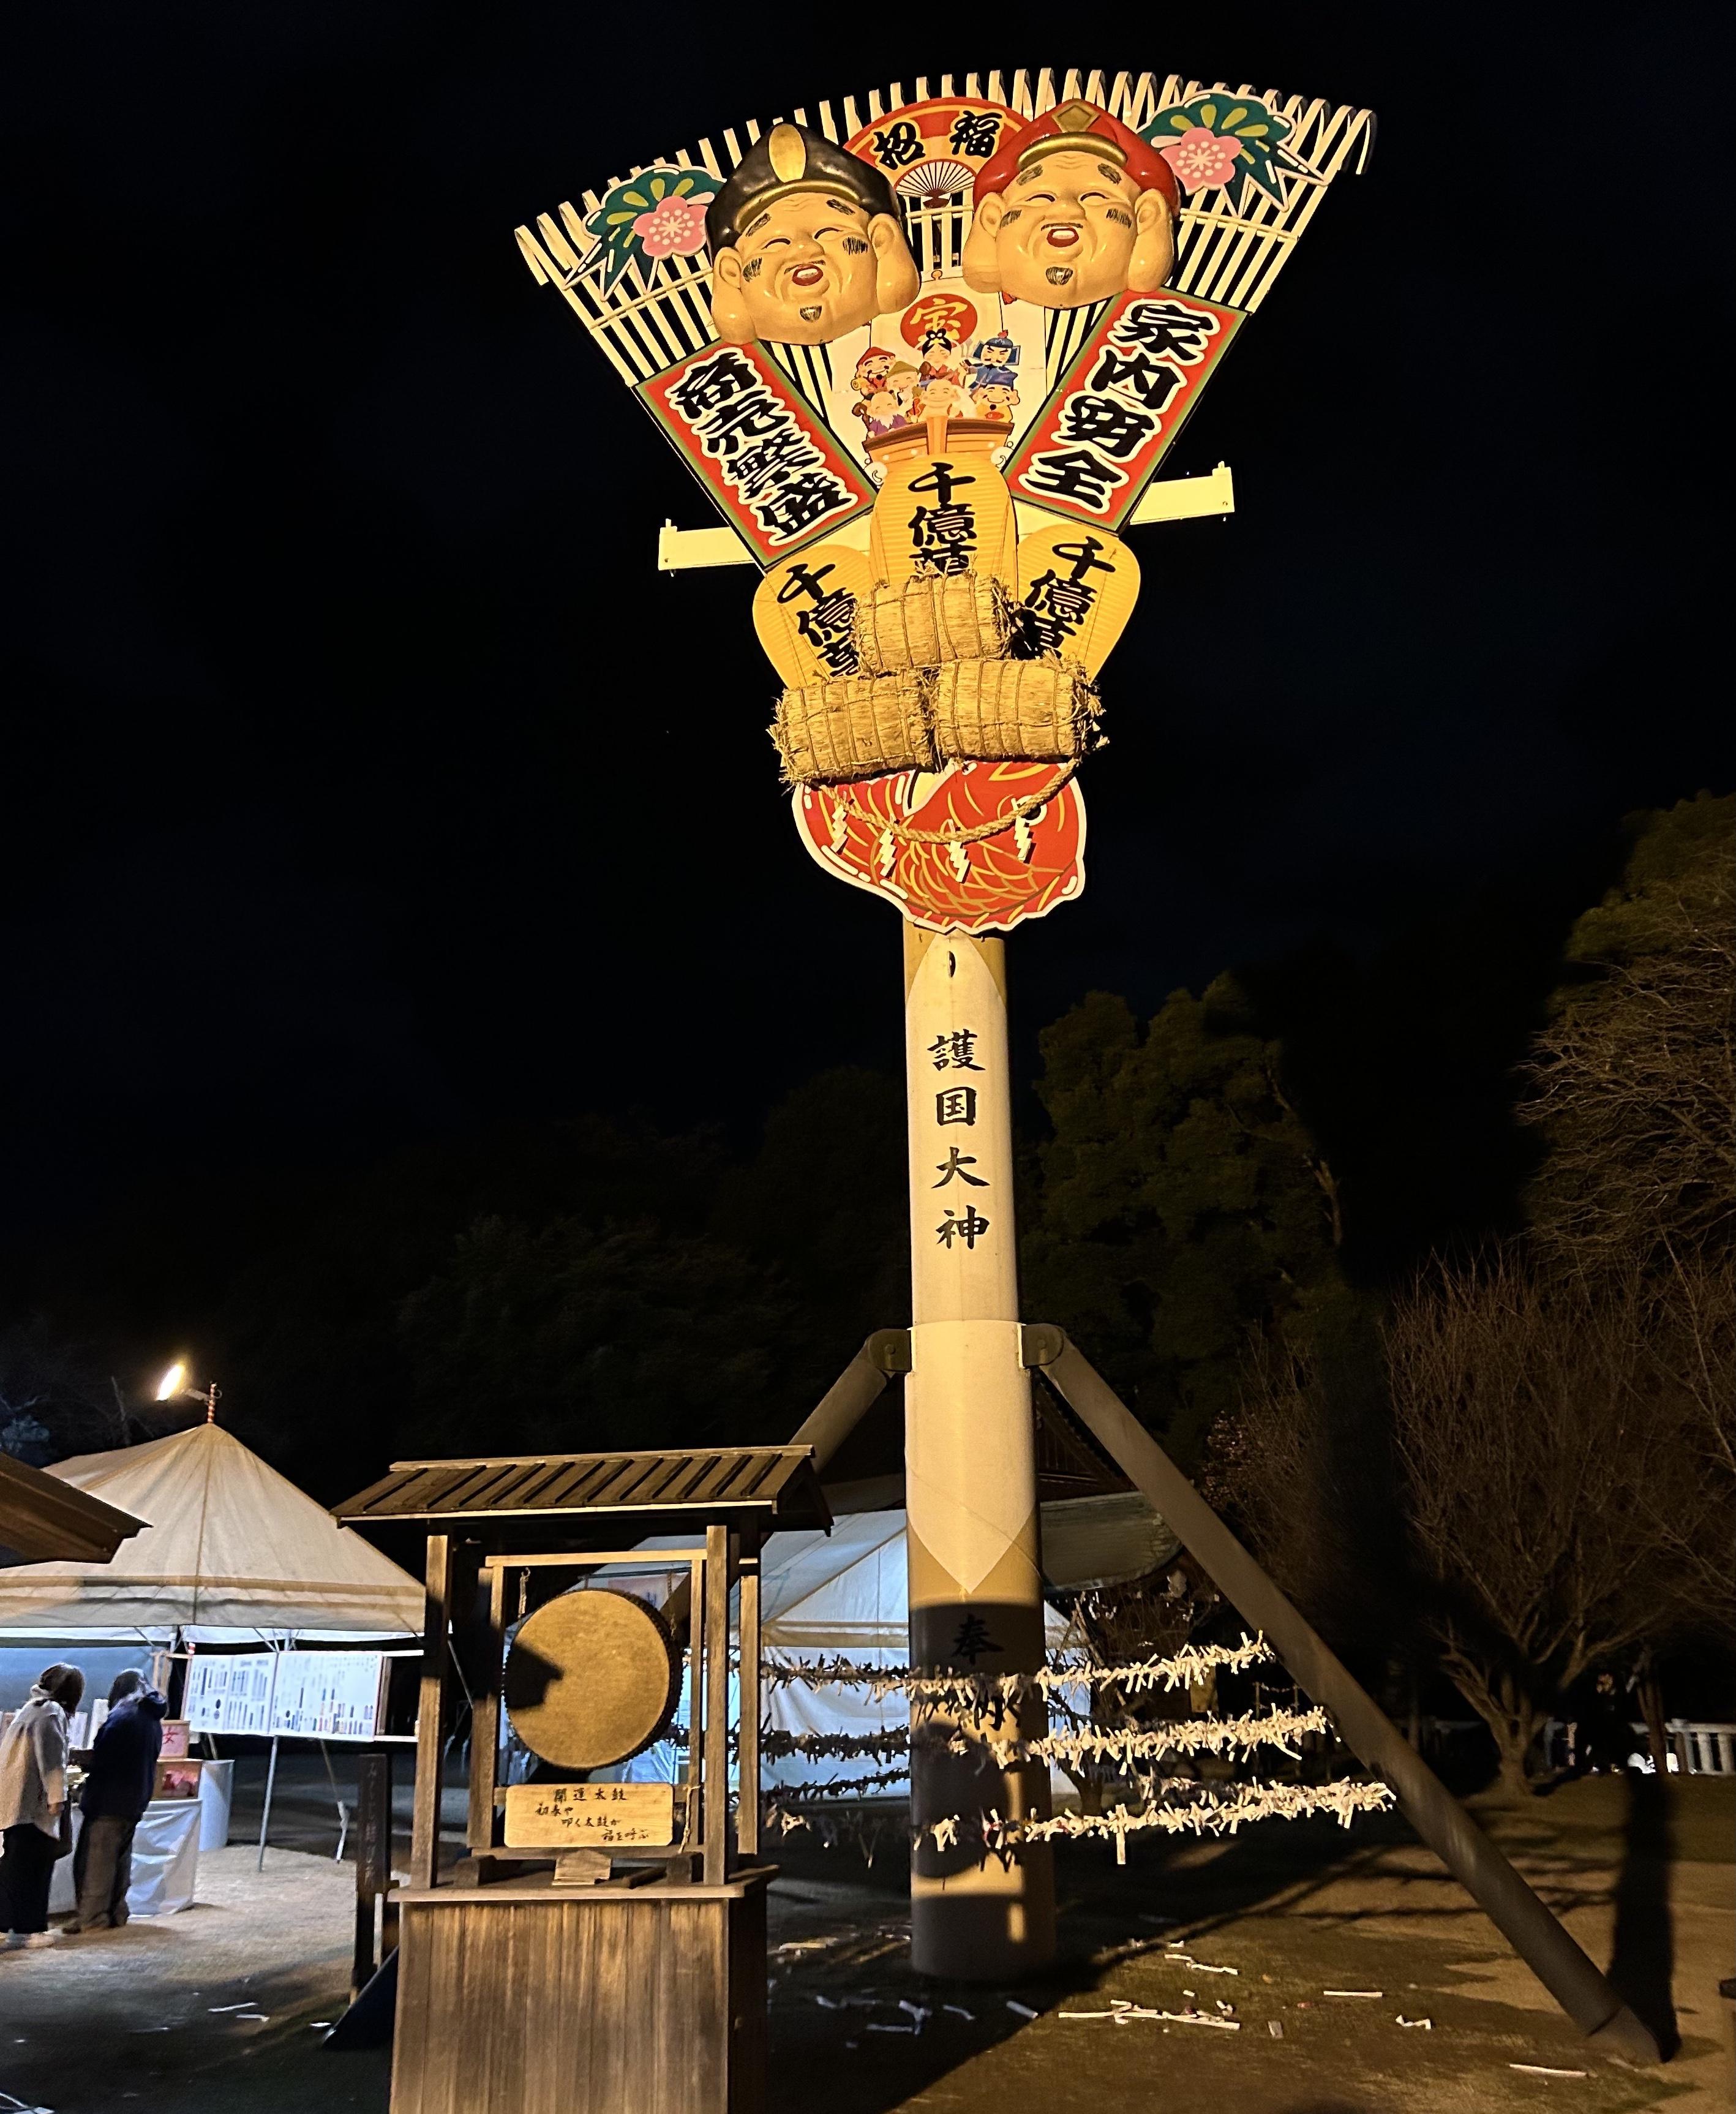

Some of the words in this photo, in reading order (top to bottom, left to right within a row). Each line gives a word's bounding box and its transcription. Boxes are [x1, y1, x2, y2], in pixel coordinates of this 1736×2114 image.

[874, 110, 1003, 170] 招福
[670, 352, 854, 541] 商売繁盛
[1024, 304, 1214, 509] 家内安全
[926, 1028, 991, 1250] 護国大神
[554, 1787, 627, 1803] 開運太鼓
